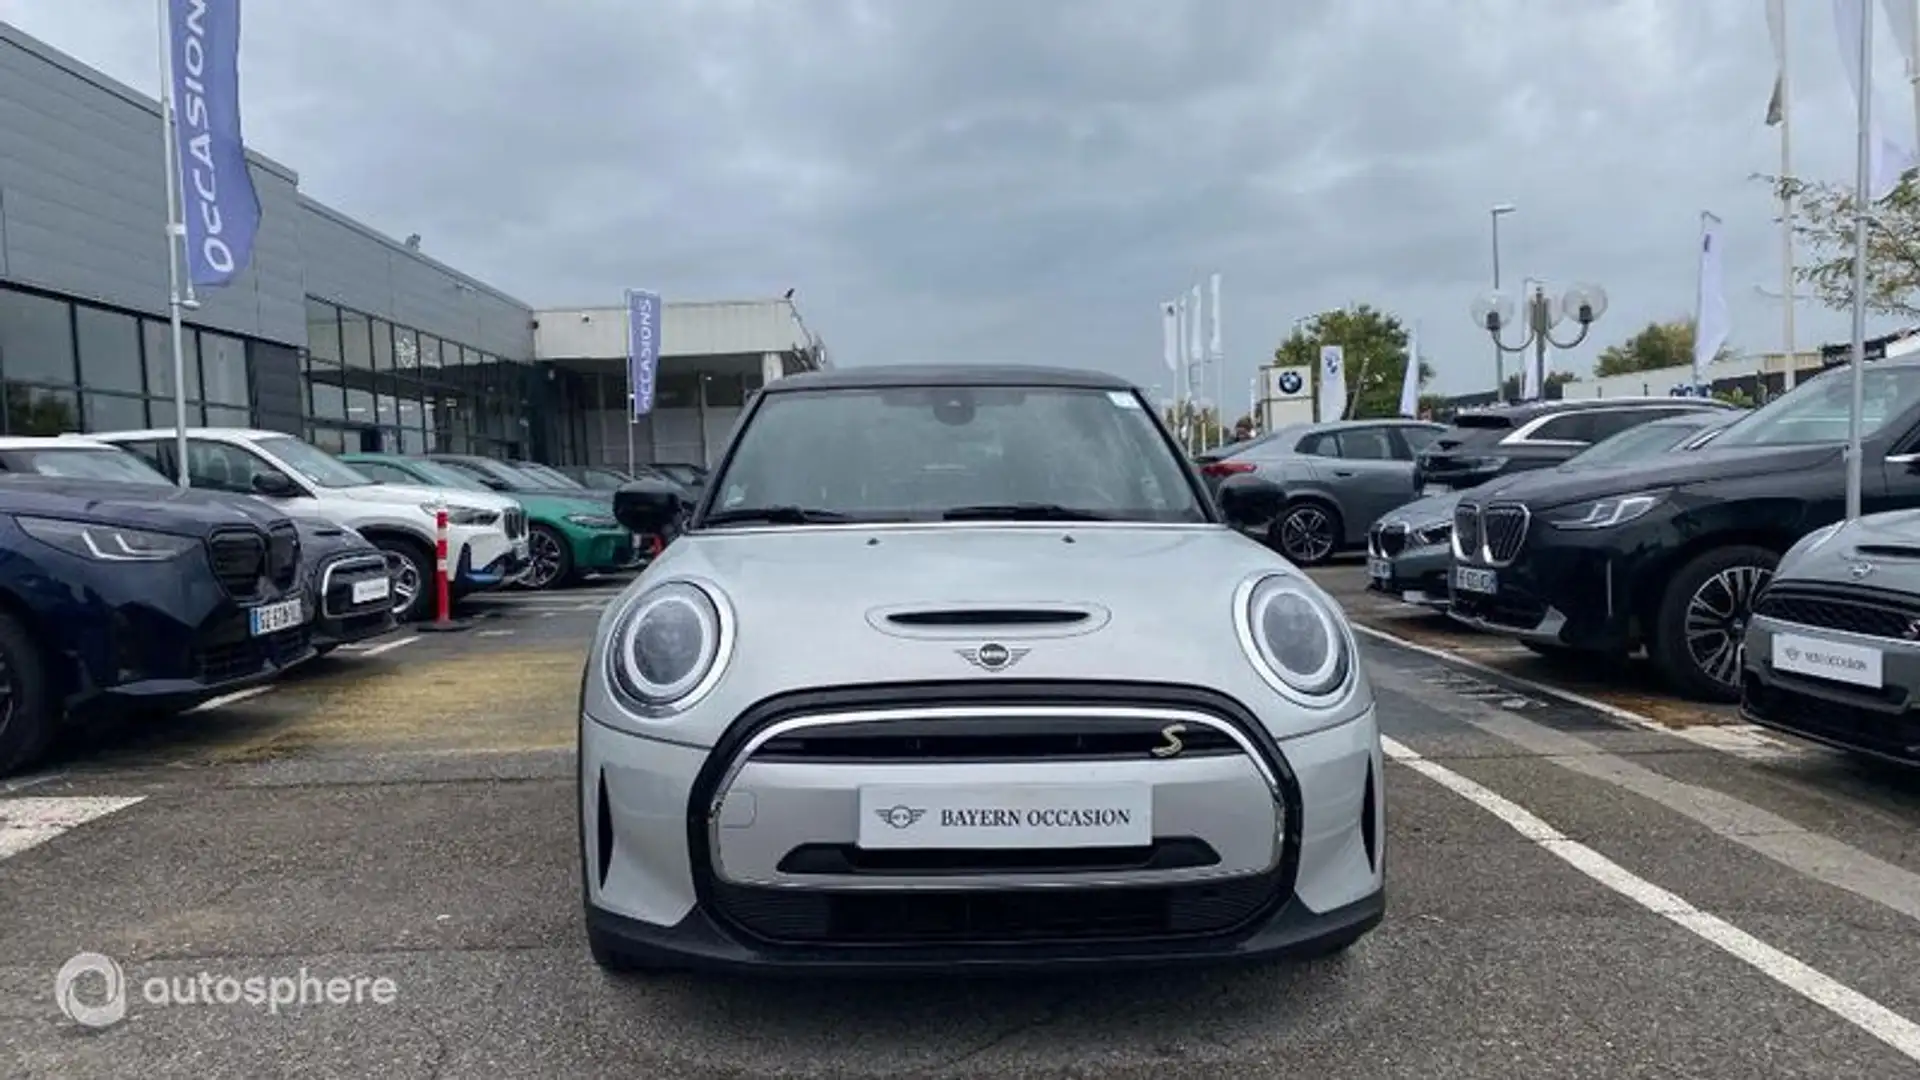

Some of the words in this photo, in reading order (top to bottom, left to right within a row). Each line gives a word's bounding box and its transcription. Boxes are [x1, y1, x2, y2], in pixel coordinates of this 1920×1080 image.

[1151, 723, 1187, 757] S
[941, 808, 1021, 827] BAYERN
[1027, 808, 1131, 827] OCCASION
